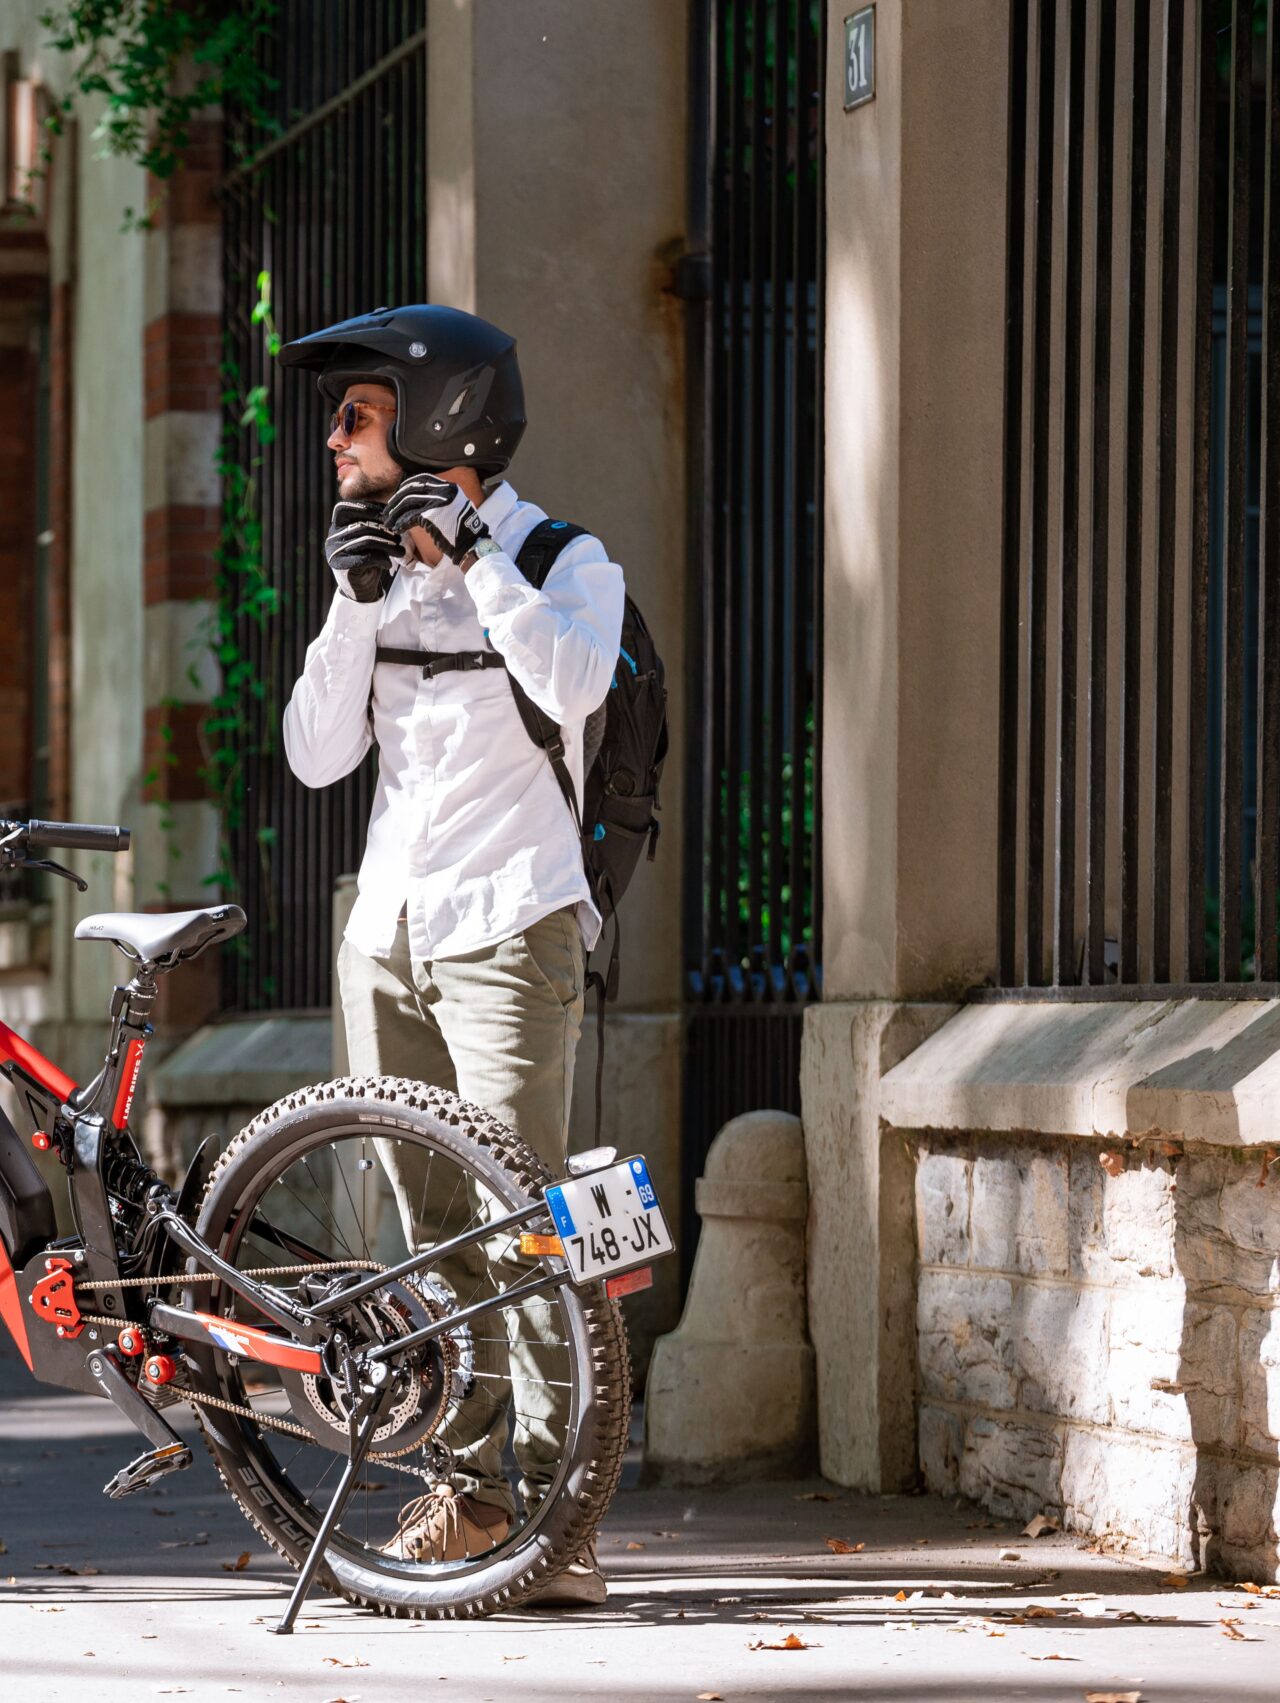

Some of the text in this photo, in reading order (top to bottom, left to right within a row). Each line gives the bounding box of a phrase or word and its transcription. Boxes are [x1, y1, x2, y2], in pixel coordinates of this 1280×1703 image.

[848, 23, 868, 92] 31
[122, 1059, 141, 1120] LMX BIKES
[590, 1183, 612, 1219] W
[638, 1183, 655, 1204] 69
[560, 1215, 568, 1228] F
[570, 1212, 661, 1273] 748-JX
